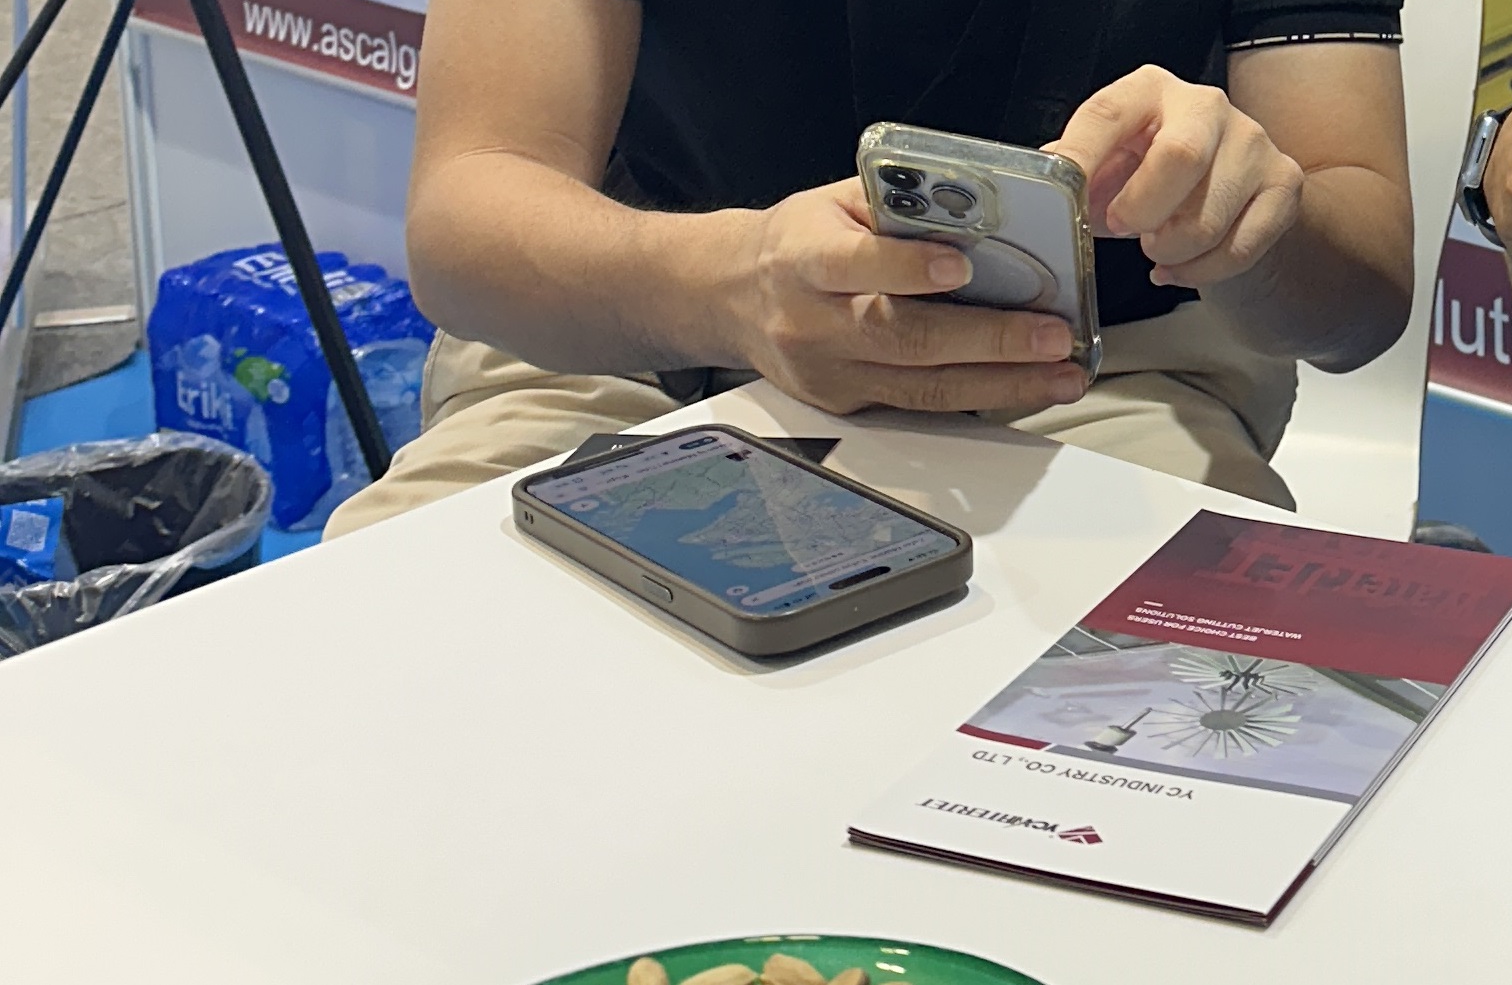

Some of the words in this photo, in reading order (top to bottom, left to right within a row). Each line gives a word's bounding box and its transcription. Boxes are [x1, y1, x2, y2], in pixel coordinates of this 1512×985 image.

[243, 0, 418, 91] www.ascalg
[1126, 614, 1163, 627] USERS
[1135, 607, 1197, 623] SOLUTIONS
[1163, 620, 1186, 630] FOR
[1185, 625, 1228, 637] CHOICE
[1197, 617, 1244, 631] CUTTING
[1229, 631, 1258, 642] BEST
[1244, 626, 1303, 640] WATERJET
[971, 750, 1012, 766] LTD
[1057, 767, 1164, 795] INDUSTRY
[1165, 786, 1195, 800] YC
